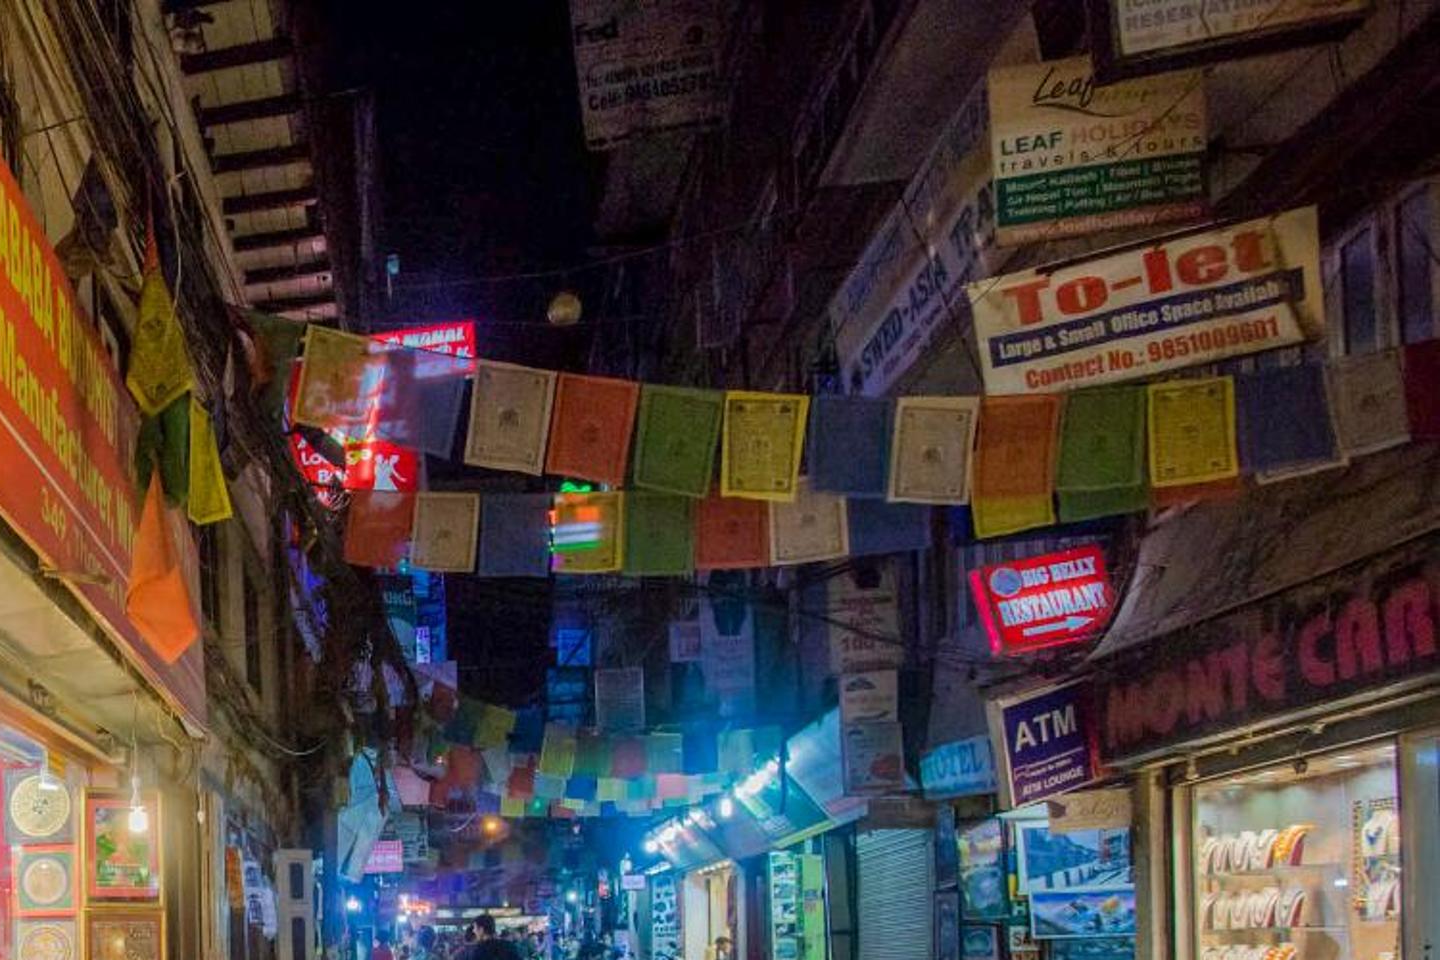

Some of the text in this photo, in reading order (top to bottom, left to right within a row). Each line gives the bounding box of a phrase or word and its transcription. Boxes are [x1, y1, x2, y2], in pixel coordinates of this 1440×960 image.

[1032, 66, 1097, 108] Leaf
[1000, 131, 1063, 156] LEAF
[1000, 150, 1090, 173] travels
[1135, 135, 1203, 154] tours
[1002, 229, 1277, 327] To-let
[998, 338, 1042, 362] Large
[1044, 334, 1059, 352] &
[1059, 322, 1106, 348] Small
[1110, 306, 1160, 334] Office
[1160, 295, 1215, 326] Space
[1024, 354, 1105, 390] Contact
[1021, 555, 1096, 588] BIG BELLY
[998, 581, 1108, 627] RESTAURANT
[1298, 576, 1438, 688] CAR
[1014, 704, 1078, 754] ATM
[1044, 765, 1085, 789] LOUNGE
